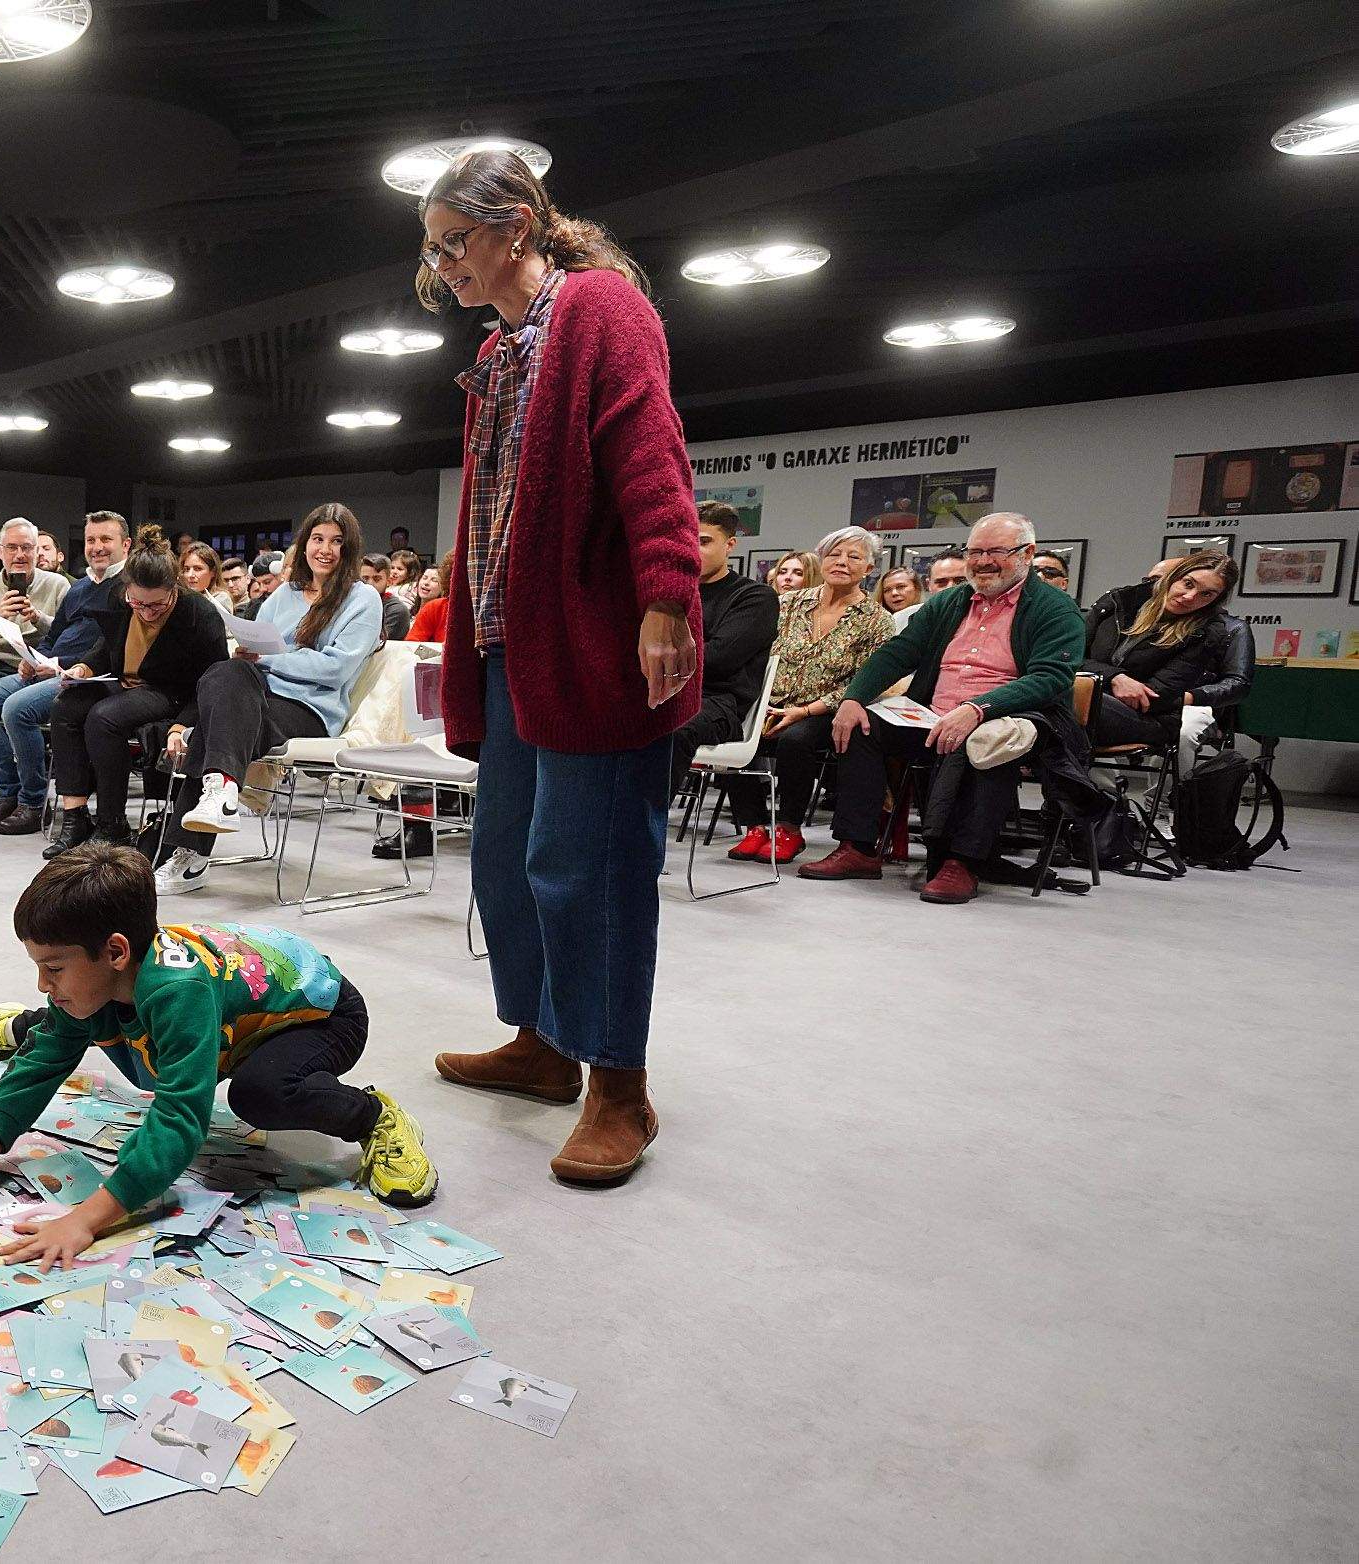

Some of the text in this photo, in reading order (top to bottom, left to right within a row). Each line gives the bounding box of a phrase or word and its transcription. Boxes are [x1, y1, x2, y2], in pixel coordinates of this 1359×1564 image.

[690, 454, 751, 476] PREMIOS
[783, 446, 850, 469] GARAXE
[857, 435, 970, 463] HERMÉTICO"
[1177, 520, 1211, 529] PREMIO
